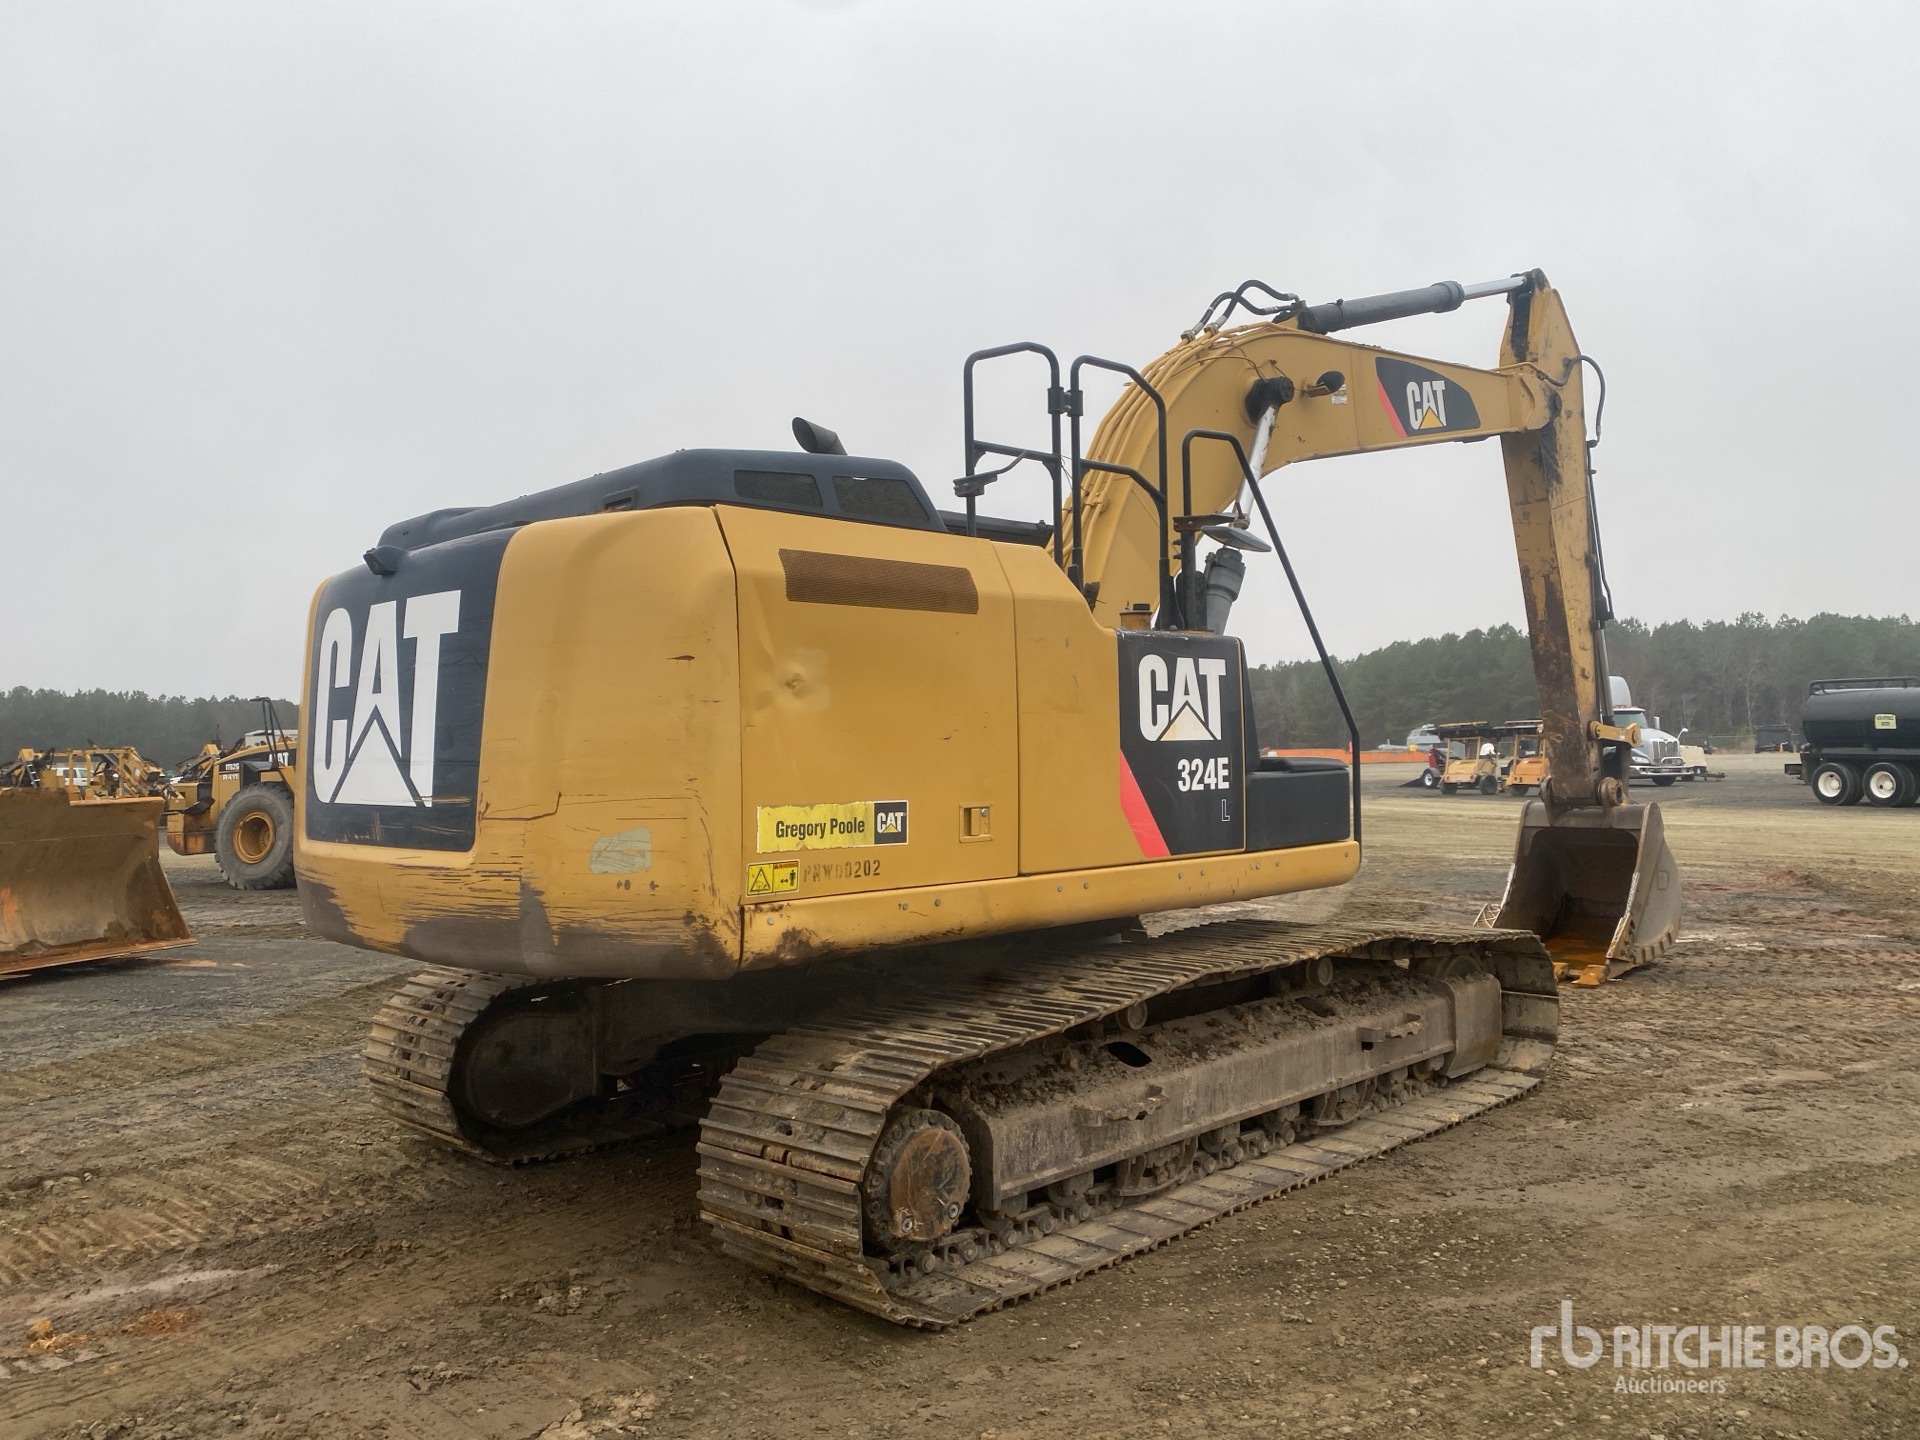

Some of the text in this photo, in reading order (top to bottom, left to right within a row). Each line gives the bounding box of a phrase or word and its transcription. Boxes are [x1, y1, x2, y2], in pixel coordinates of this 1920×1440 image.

[1407, 380, 1447, 430] CAT
[313, 590, 461, 807] CAT
[1138, 654, 1226, 741] CAT
[1177, 756, 1230, 792] 324E
[877, 812, 904, 834] CAT
[1221, 799, 1230, 821] L
[775, 817, 865, 840] Gregory Poole
